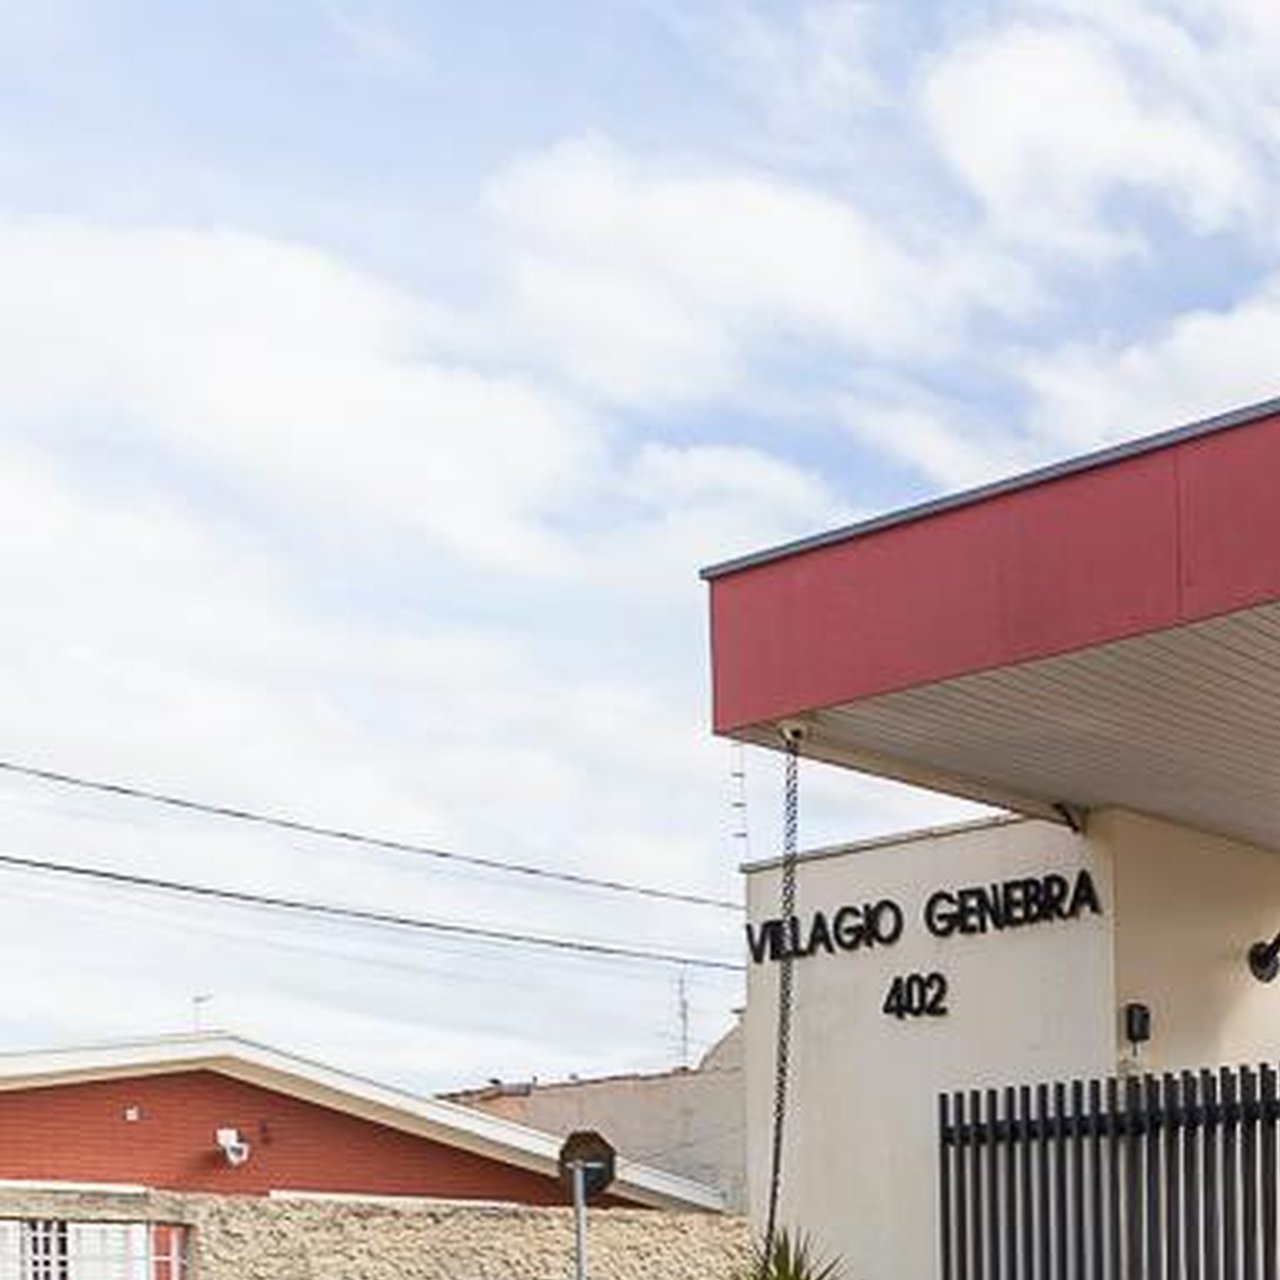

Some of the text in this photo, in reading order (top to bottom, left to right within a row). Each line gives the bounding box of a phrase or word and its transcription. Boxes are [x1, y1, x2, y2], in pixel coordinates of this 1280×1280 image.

[746, 868, 1102, 964] VILLAGIO GENEBRA
[883, 972, 948, 1020] 402
